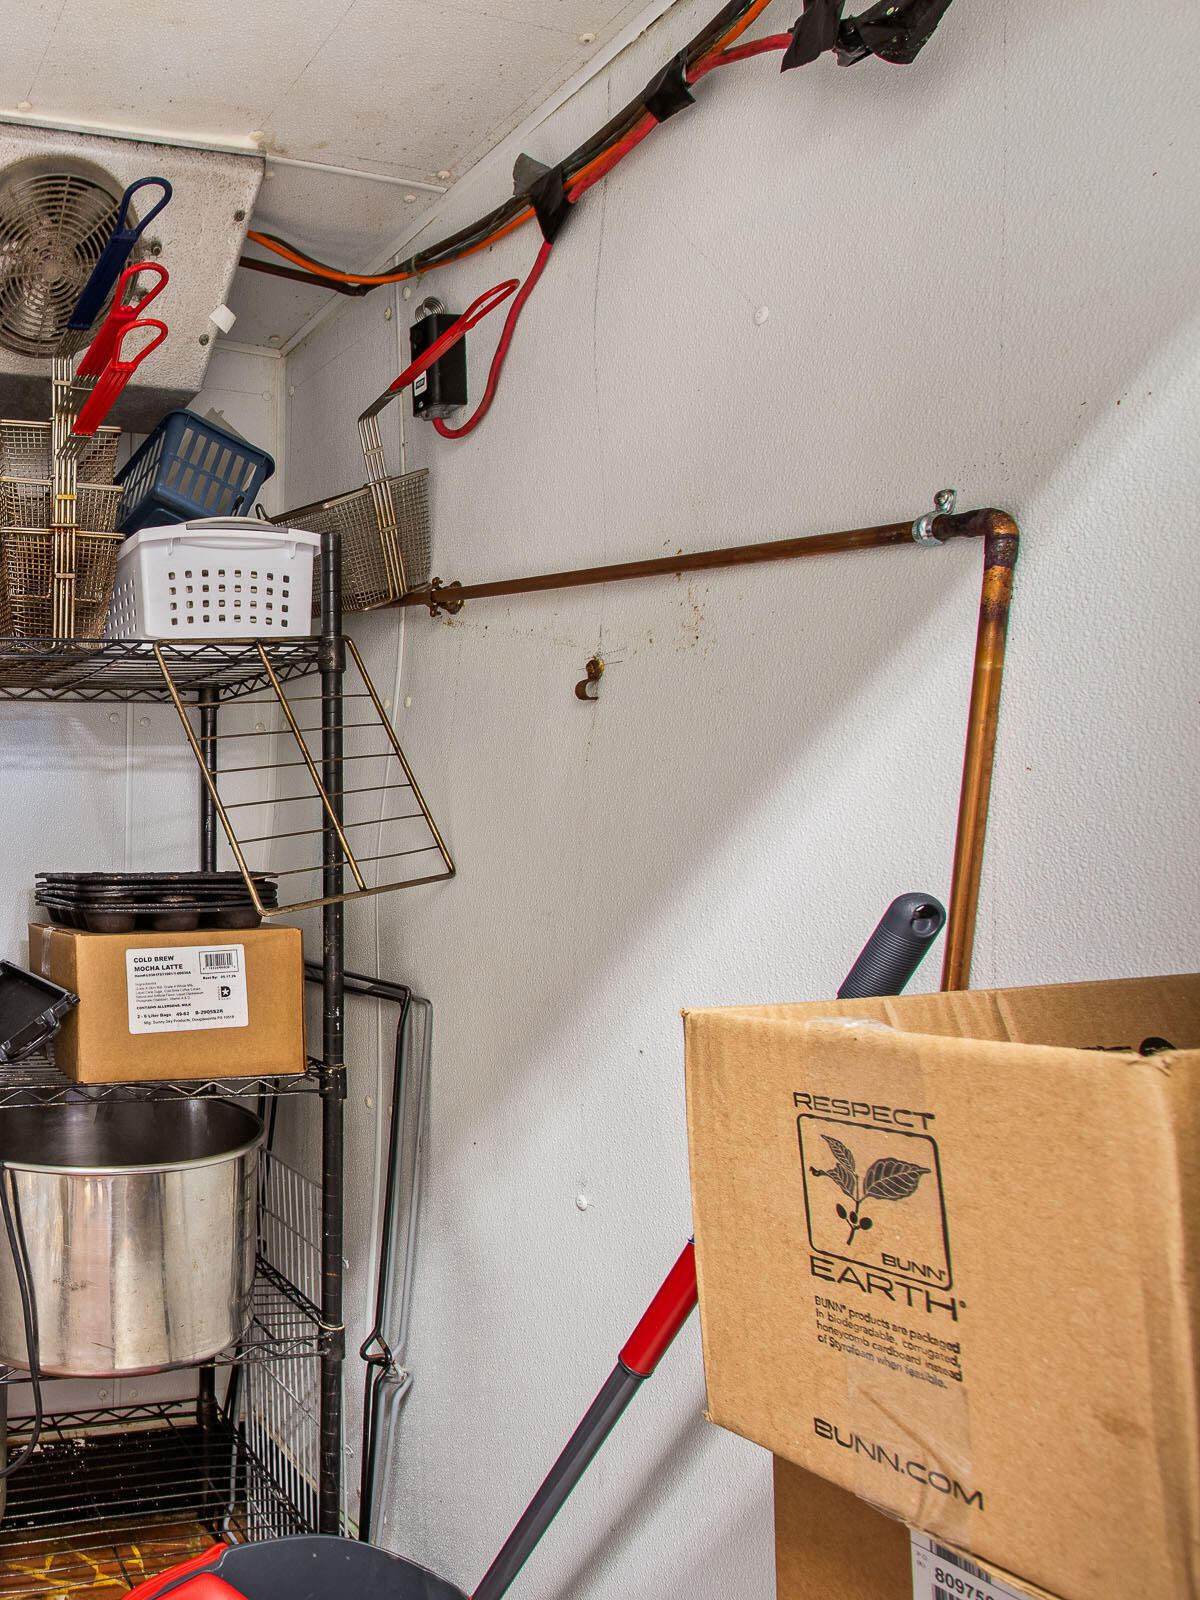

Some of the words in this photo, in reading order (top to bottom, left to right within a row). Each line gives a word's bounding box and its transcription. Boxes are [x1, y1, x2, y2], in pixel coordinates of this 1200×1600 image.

[161, 963, 183, 971] LATTE
[793, 1092, 936, 1130] RESPECT
[816, 1308, 825, 1318] in
[827, 1312, 898, 1345] biodegradable,
[903, 1341, 961, 1368] corrugated,
[816, 1320, 870, 1347] honeycomb
[872, 1343, 922, 1366] cardboard
[925, 1361, 963, 1382] instead
[848, 1309, 890, 1330] products
[892, 1324, 908, 1335] are
[910, 1330, 961, 1354] packaged
[817, 1335, 828, 1344] of
[829, 1336, 875, 1361] Styrofoam
[877, 1356, 903, 1371] when
[814, 1417, 984, 1511] BUNN.COM
[935, 1567, 995, 1600] 80975
